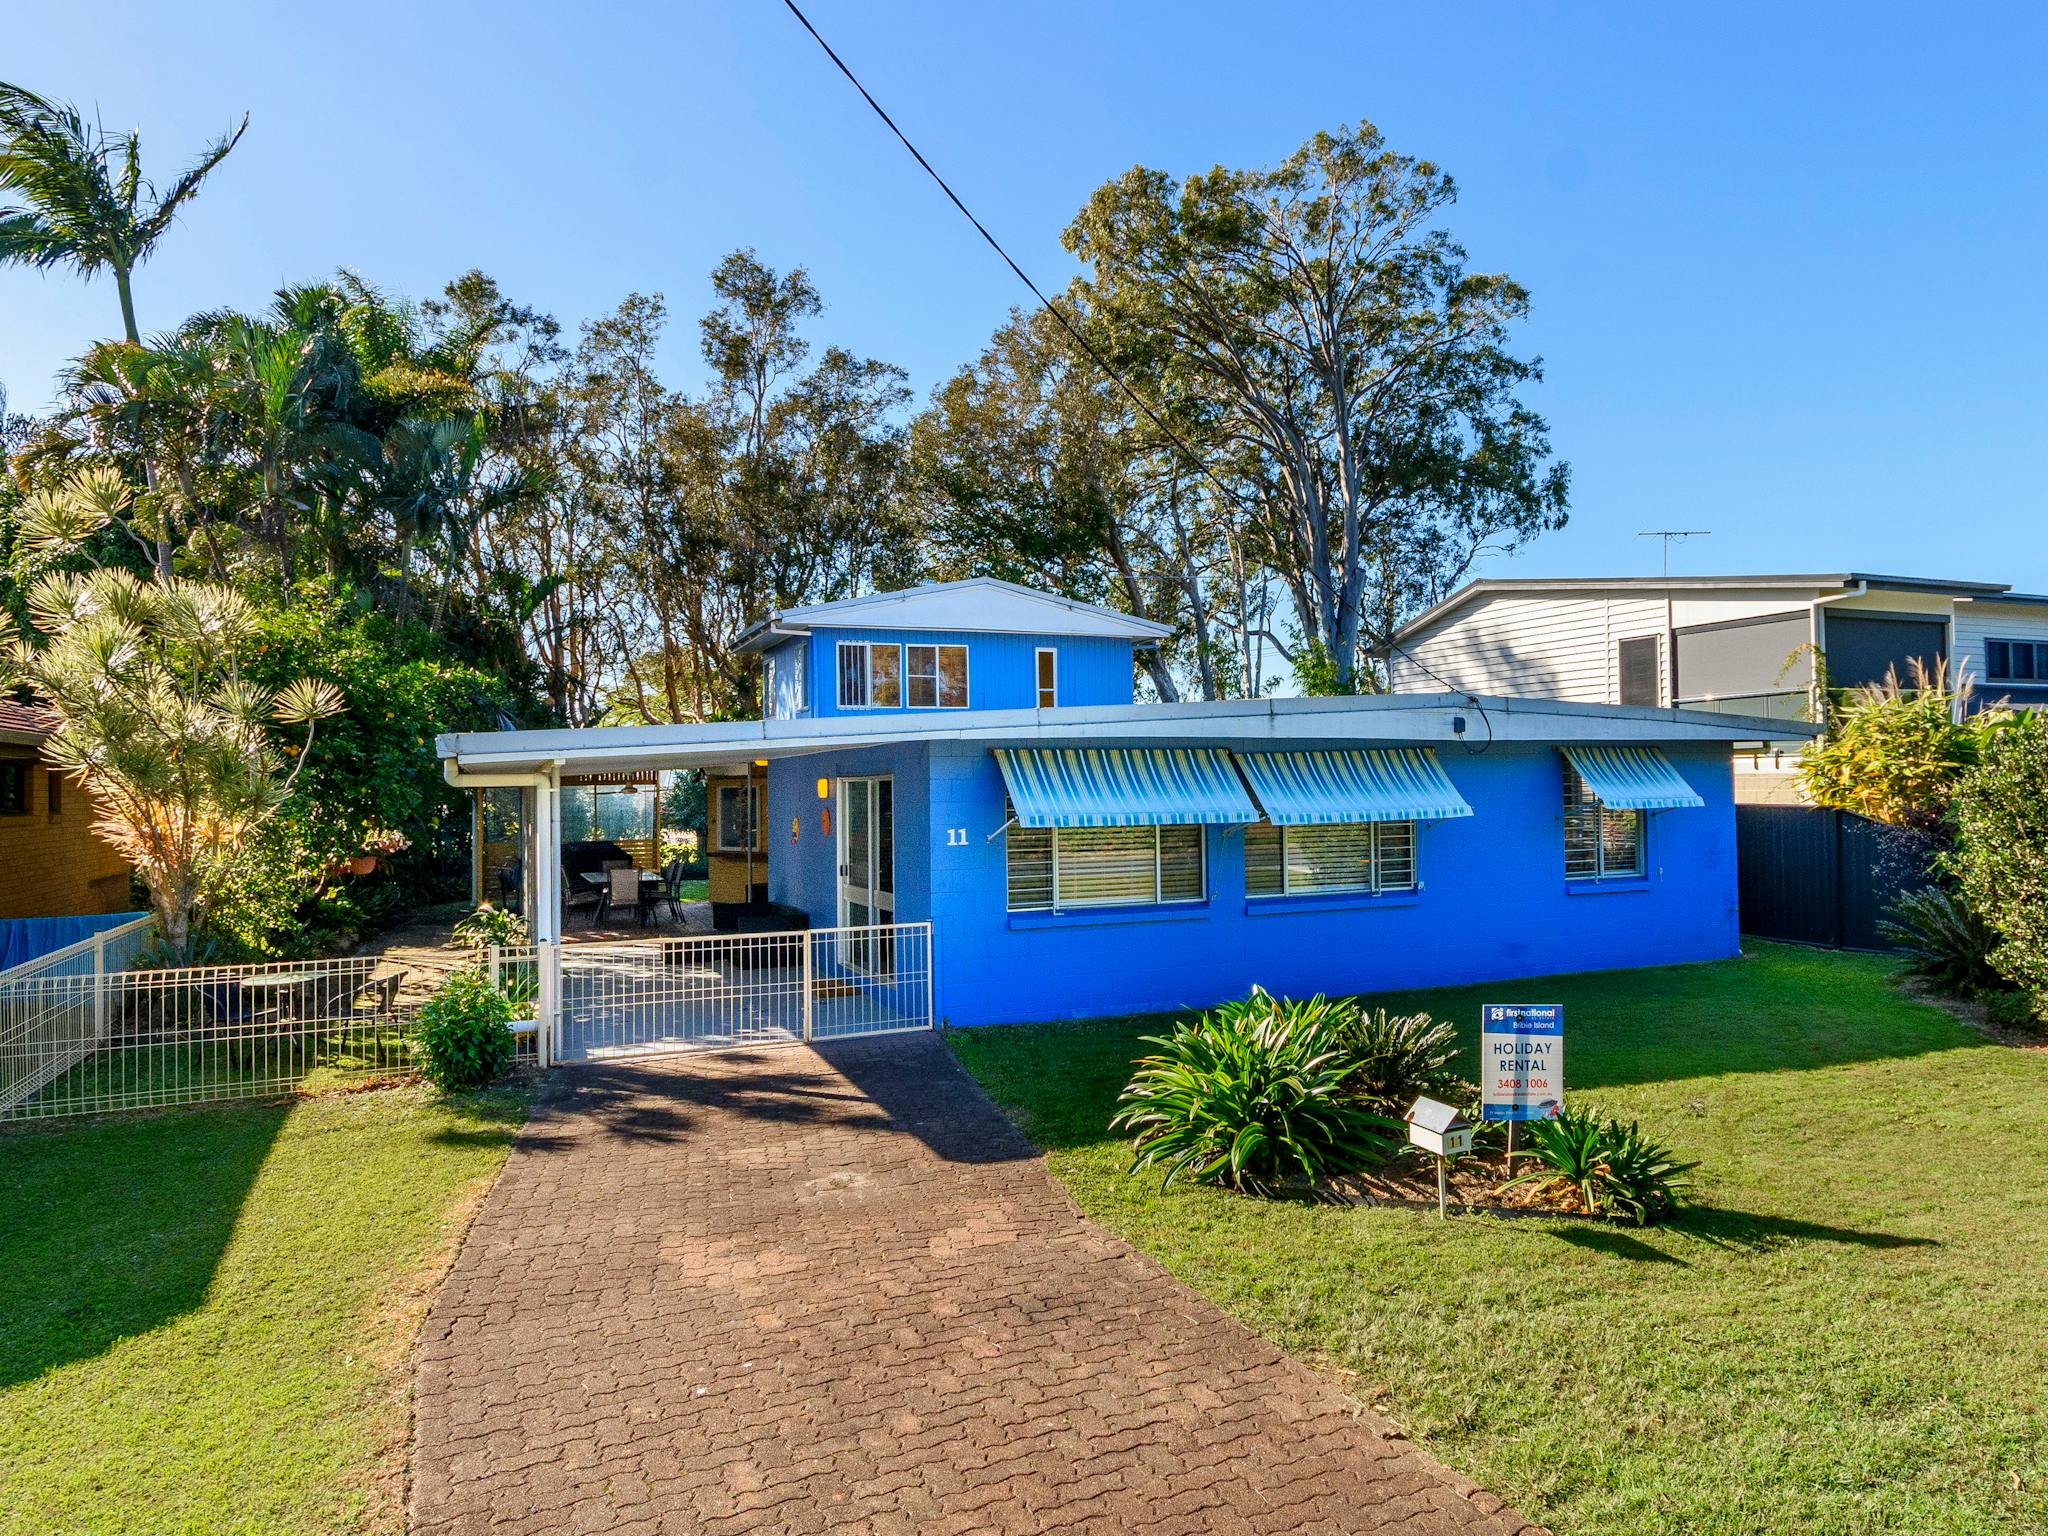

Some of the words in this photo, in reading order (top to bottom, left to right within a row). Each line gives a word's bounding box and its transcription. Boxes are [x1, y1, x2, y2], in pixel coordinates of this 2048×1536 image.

[947, 828, 969, 846] 11
[1513, 1021, 1533, 1029] Bribie
[1534, 1021, 1555, 1029] Island
[1494, 1043, 1552, 1055] HOLIDAY
[1500, 1060, 1547, 1072] RENTAL
[1497, 1079, 1522, 1089] 3408
[1525, 1079, 1548, 1089] 1006
[1450, 1135, 1463, 1149] 11
